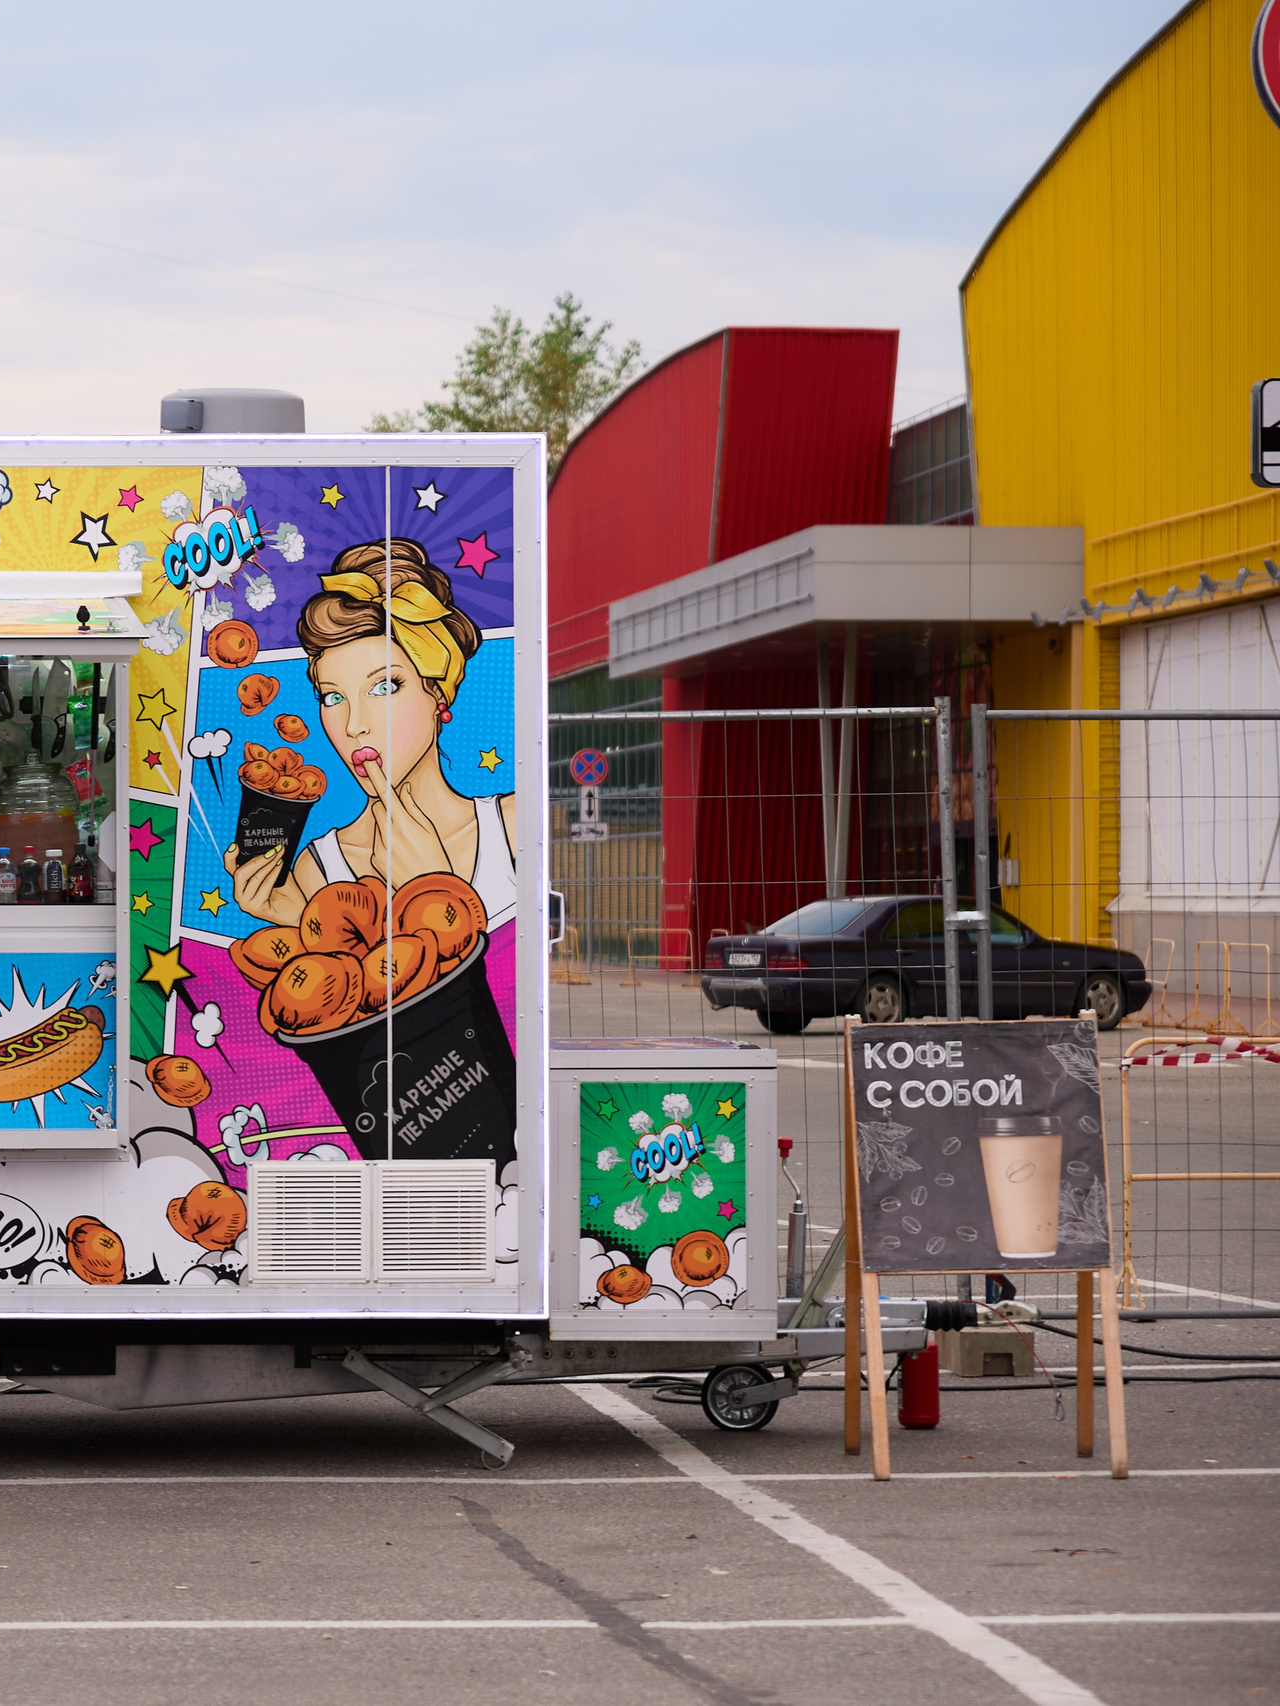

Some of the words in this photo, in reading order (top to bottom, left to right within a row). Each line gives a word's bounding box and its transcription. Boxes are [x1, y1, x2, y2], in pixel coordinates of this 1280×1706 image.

[163, 505, 264, 589] COOL!
[243, 837, 289, 848] ПЕЛЬМЕНИ
[244, 827, 284, 837] ЖАРЕНЫЕ
[50, 870, 59, 889] Rich
[863, 1040, 965, 1069] КОФЕ
[383, 1049, 465, 1125] ЖАРЕНЫЕ
[397, 1060, 490, 1146] ПЕЛЬМЕНИ
[866, 1080, 893, 1108] С
[899, 1073, 1023, 1108] СОБОЙ
[630, 1121, 706, 1182] COOL!
